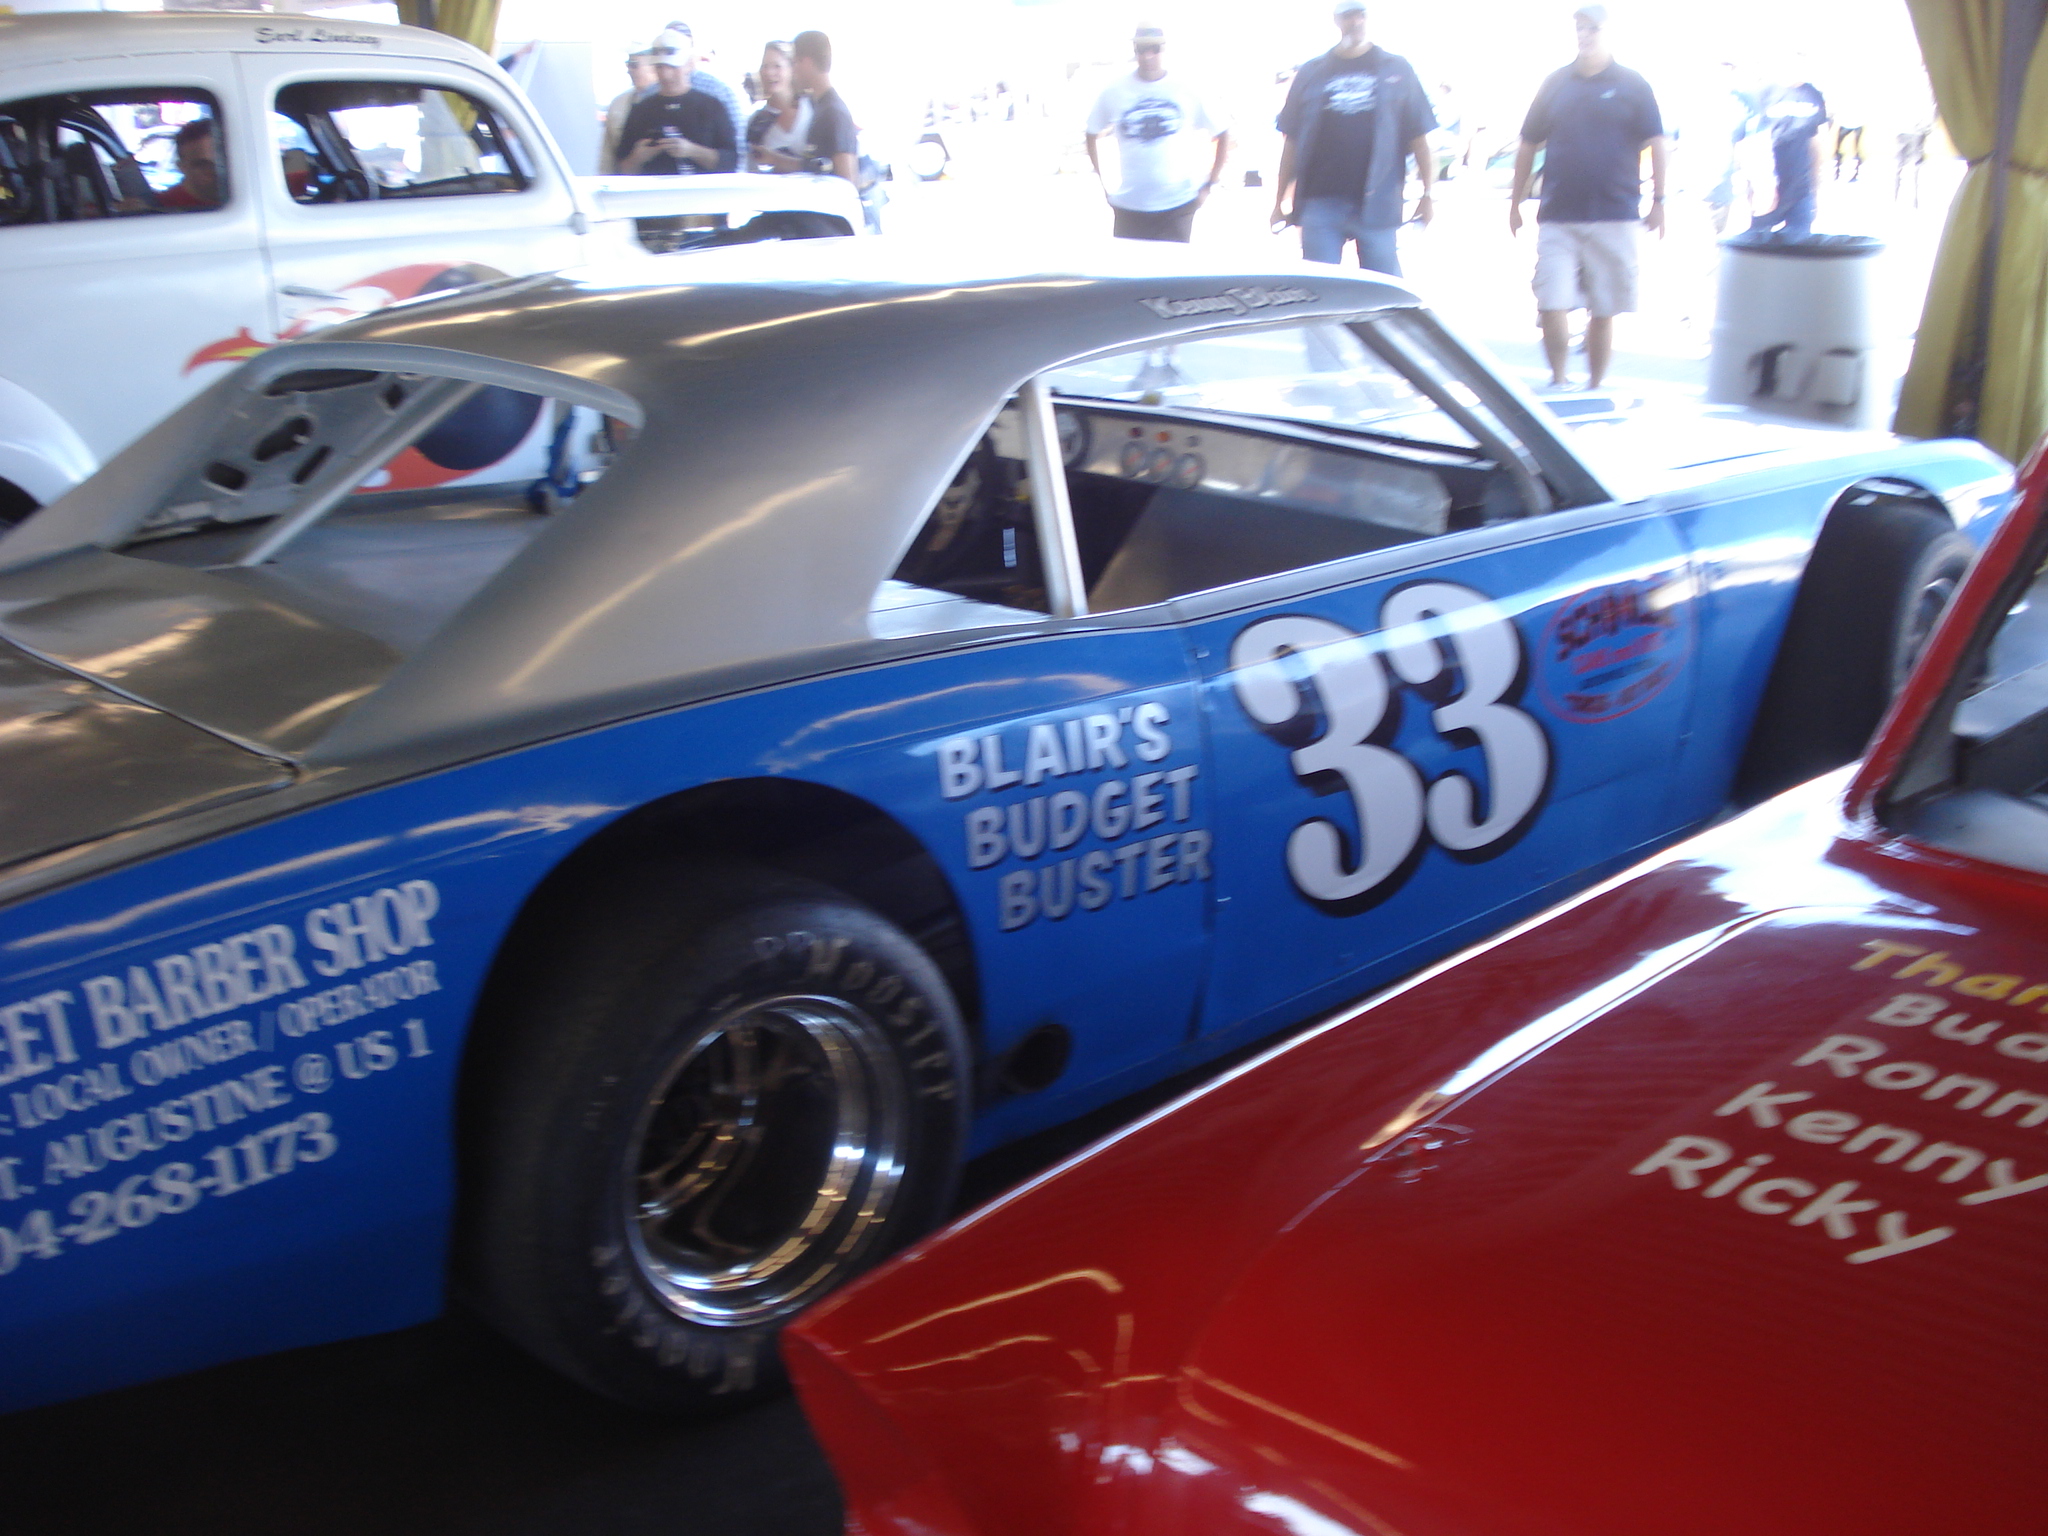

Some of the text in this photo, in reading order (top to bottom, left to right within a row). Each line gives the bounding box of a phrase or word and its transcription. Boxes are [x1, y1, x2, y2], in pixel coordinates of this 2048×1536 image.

[936, 702, 1171, 800] BLAIR'S
[1229, 580, 1553, 908] 33
[965, 764, 1198, 870] BUDGET
[999, 829, 1213, 932] BUSTER
[81, 923, 309, 1049] BARBER
[304, 879, 440, 977] SHOP
[10, 1062, 134, 1130] LOCAL
[44, 1065, 292, 1185] AUGUSTINE
[333, 1030, 399, 1079] US
[402, 1018, 434, 1058] 1
[1714, 1081, 2048, 1206] Kenny
[1628, 1135, 1957, 1265] Ricky
